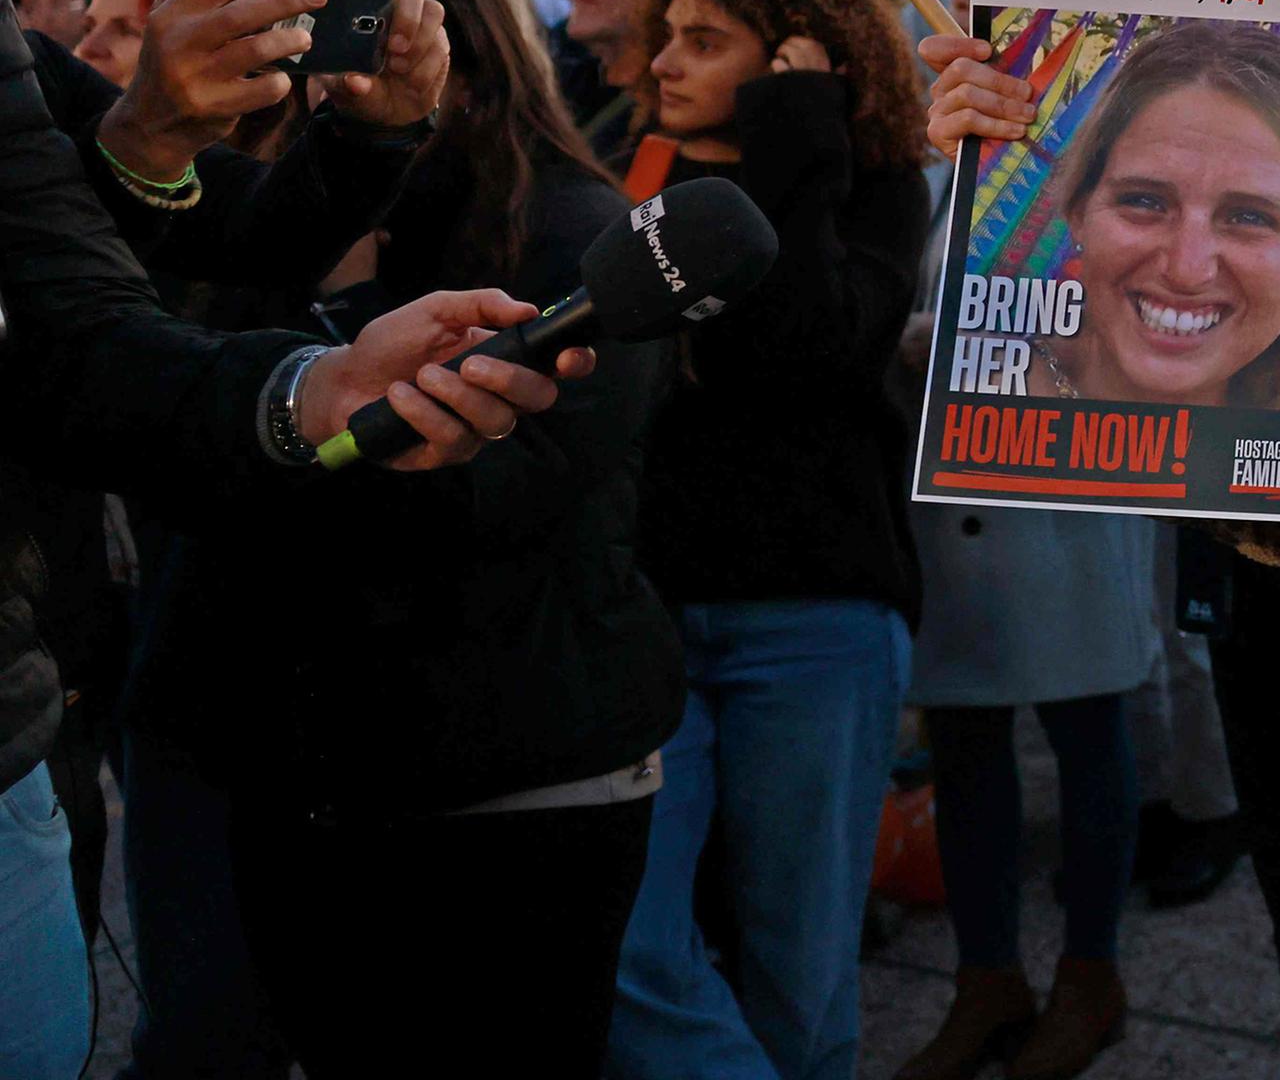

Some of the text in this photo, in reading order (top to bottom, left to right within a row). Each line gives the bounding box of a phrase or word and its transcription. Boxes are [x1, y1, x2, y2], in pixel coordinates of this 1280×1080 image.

[958, 273, 1084, 336] BRING
[949, 336, 1032, 396] HER
[940, 403, 1191, 476] HOME NOW!
